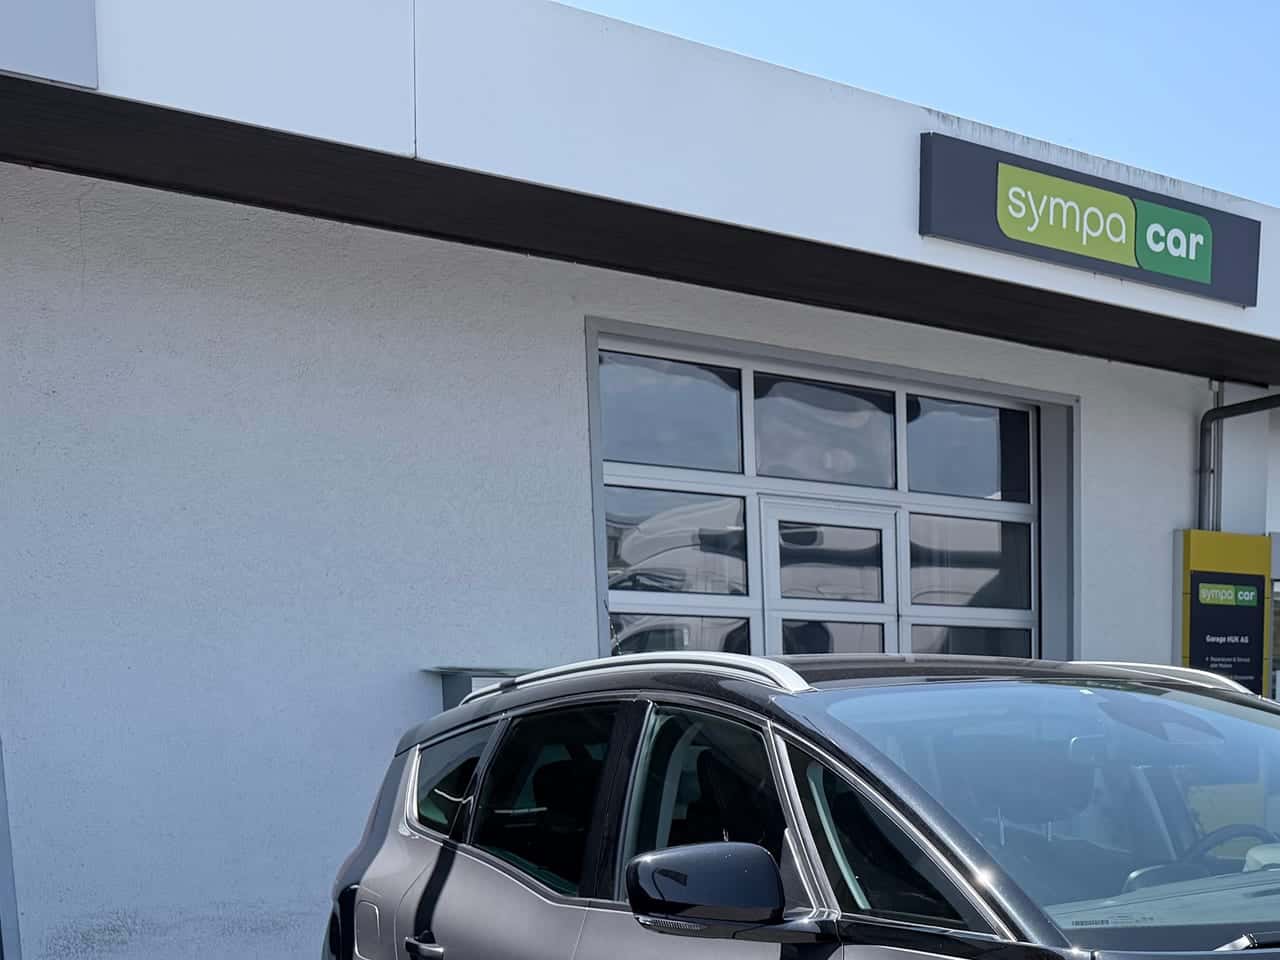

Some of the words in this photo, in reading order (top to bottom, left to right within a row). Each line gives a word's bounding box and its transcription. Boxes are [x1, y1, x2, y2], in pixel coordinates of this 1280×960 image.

[1007, 186, 1127, 245] sympa
[1145, 221, 1205, 261] car
[1201, 588, 1233, 601] sympa
[1237, 590, 1256, 601] car
[1206, 635, 1226, 645] Garage
